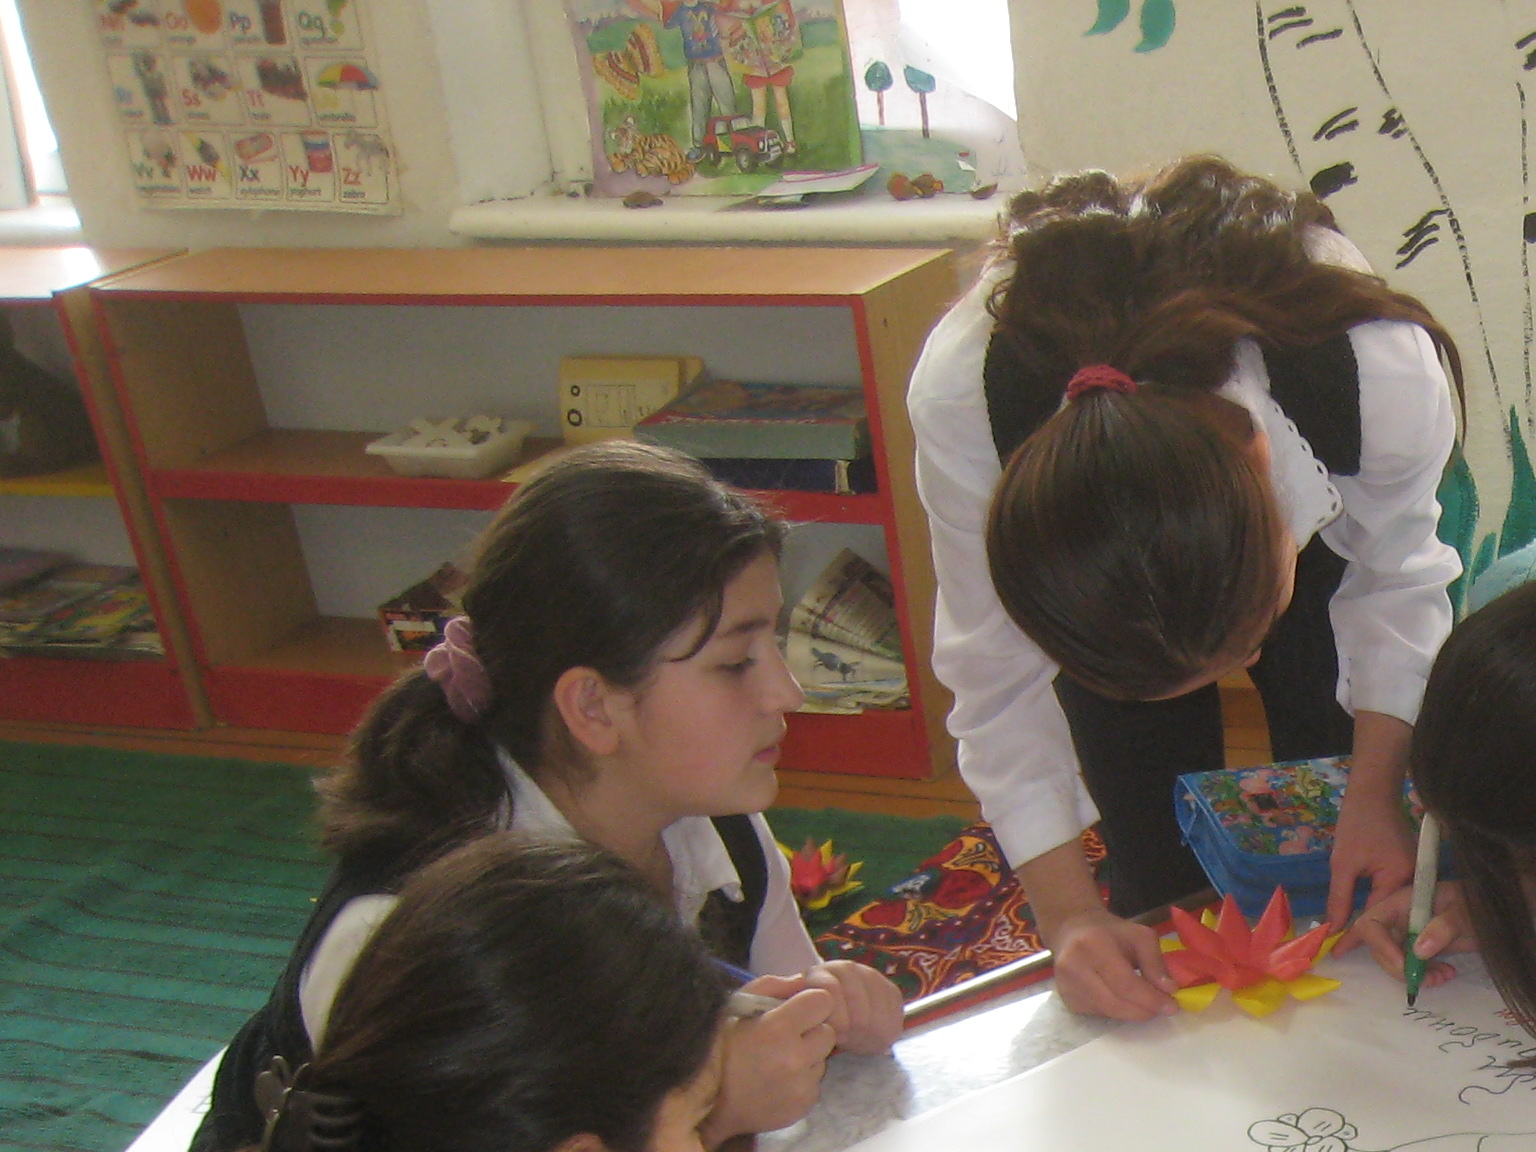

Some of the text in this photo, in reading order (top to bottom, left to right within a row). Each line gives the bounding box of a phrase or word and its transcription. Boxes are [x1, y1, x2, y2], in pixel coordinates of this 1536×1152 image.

[182, 88, 201, 107] Ss
[187, 163, 217, 182] Ww
[239, 164, 260, 182] Xx
[289, 165, 309, 188] Yy
[342, 167, 362, 186] Zz
